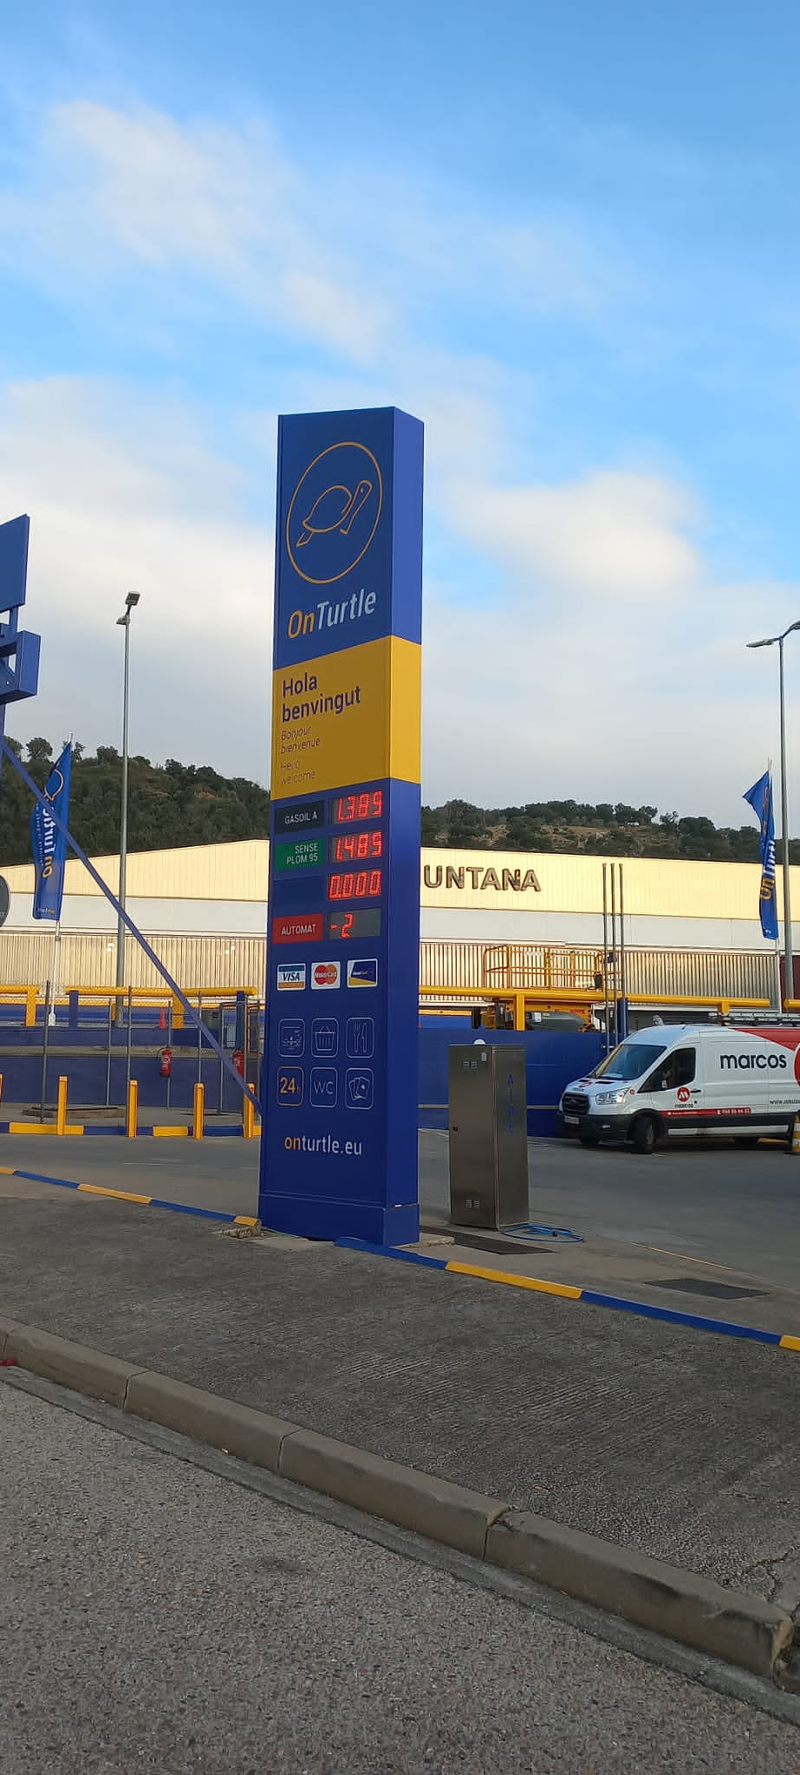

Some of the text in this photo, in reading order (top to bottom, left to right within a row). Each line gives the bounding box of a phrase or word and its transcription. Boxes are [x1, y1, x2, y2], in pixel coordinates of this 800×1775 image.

[287, 588, 377, 639] OnTurtle
[282, 672, 318, 698] Hola
[282, 686, 361, 723] benvingut
[281, 726, 312, 742] Bonjour
[280, 737, 321, 755] bienvenue
[284, 811, 318, 825] GASOIL A
[294, 843, 319, 855] SENSE
[286, 853, 319, 865] PLOM 95
[281, 924, 317, 936] AUTOMAT
[282, 972, 300, 982] VISA
[720, 1054, 787, 1069] marcos
[313, 1081, 334, 1095] WC
[284, 1135, 362, 1155] onturtle.eu
